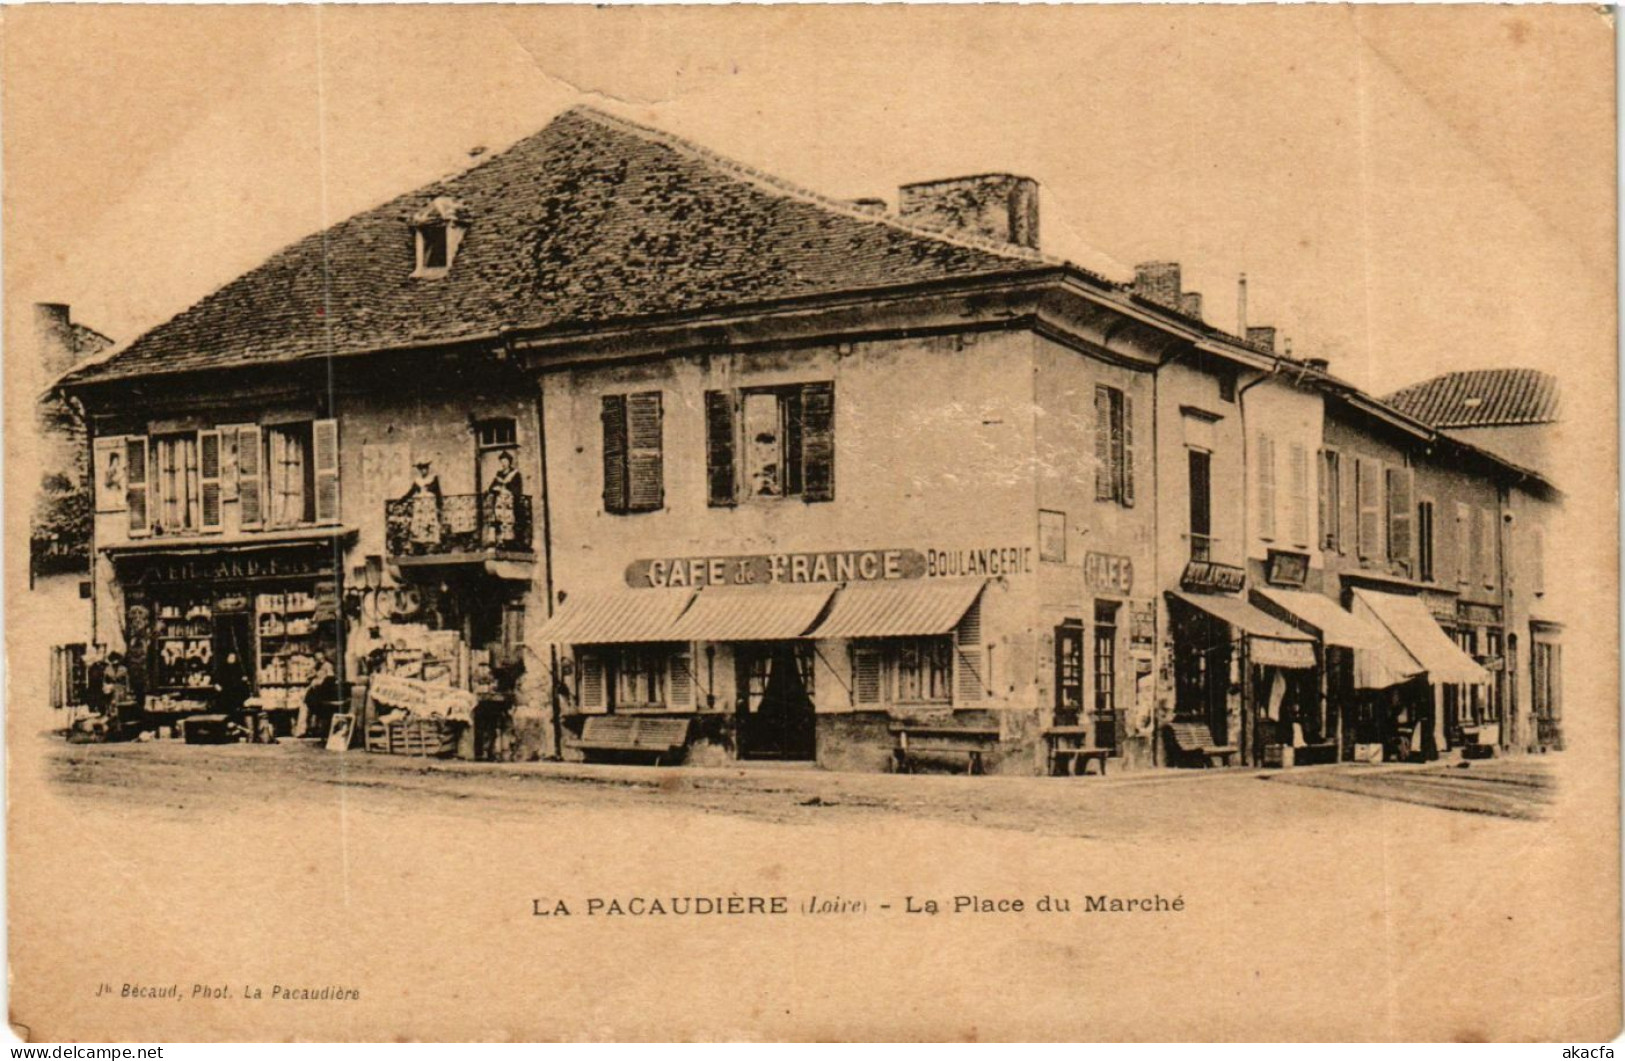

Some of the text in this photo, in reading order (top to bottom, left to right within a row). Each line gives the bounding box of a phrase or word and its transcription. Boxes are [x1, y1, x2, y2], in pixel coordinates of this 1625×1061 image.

[645, 551, 902, 587] CAFE de FRANCE
[927, 546, 1032, 577] BOULANGERIE
[1087, 553, 1131, 593] CAFE
